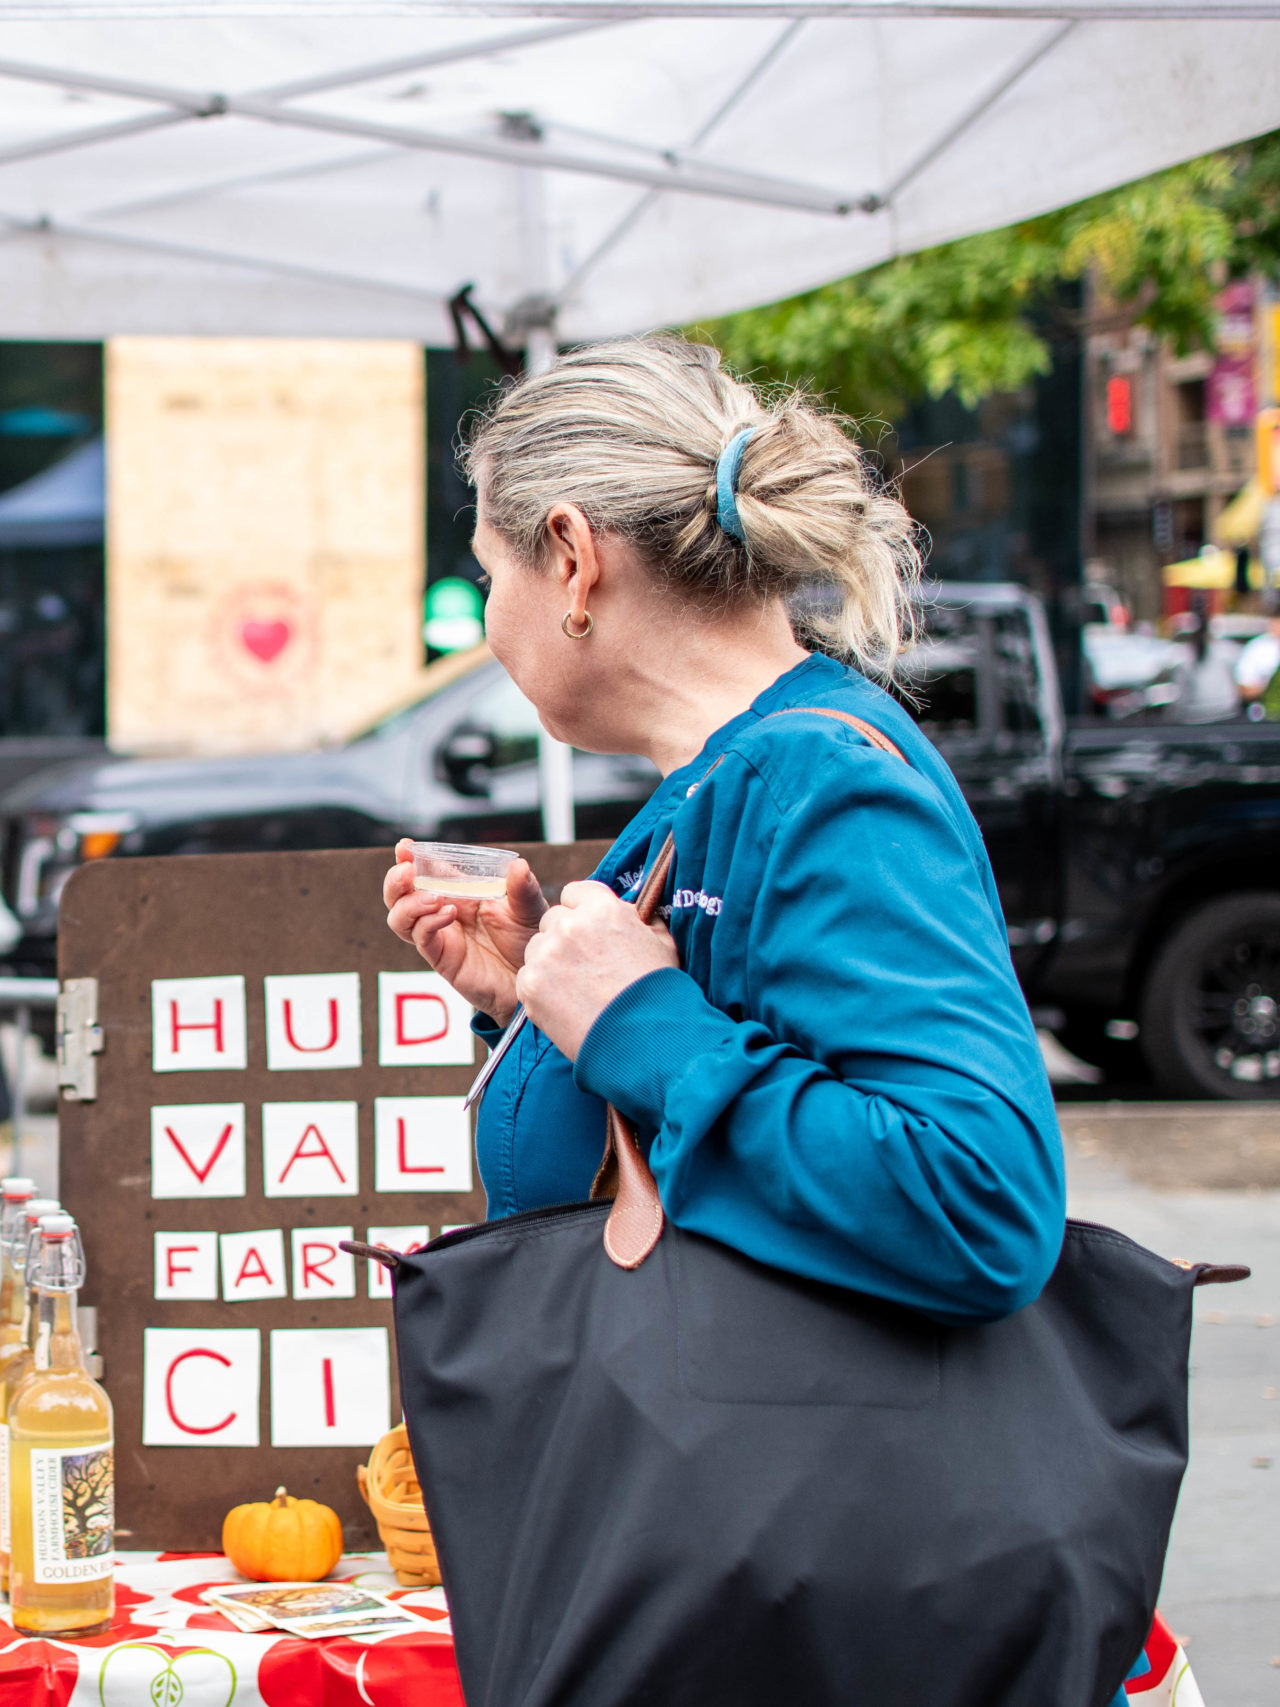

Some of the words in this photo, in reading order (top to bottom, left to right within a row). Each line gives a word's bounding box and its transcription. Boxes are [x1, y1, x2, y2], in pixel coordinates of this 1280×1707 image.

[169, 992, 450, 1053] HUD
[164, 1116, 445, 1184] VAL
[164, 1347, 337, 1436] CI
[36, 1457, 46, 1505] VALLEY
[47, 1457, 58, 1490] CIDER
[37, 1508, 48, 1561] HUDSON
[49, 1492, 61, 1561] FARMHOUSE
[42, 1563, 98, 1578] GOLDEN
